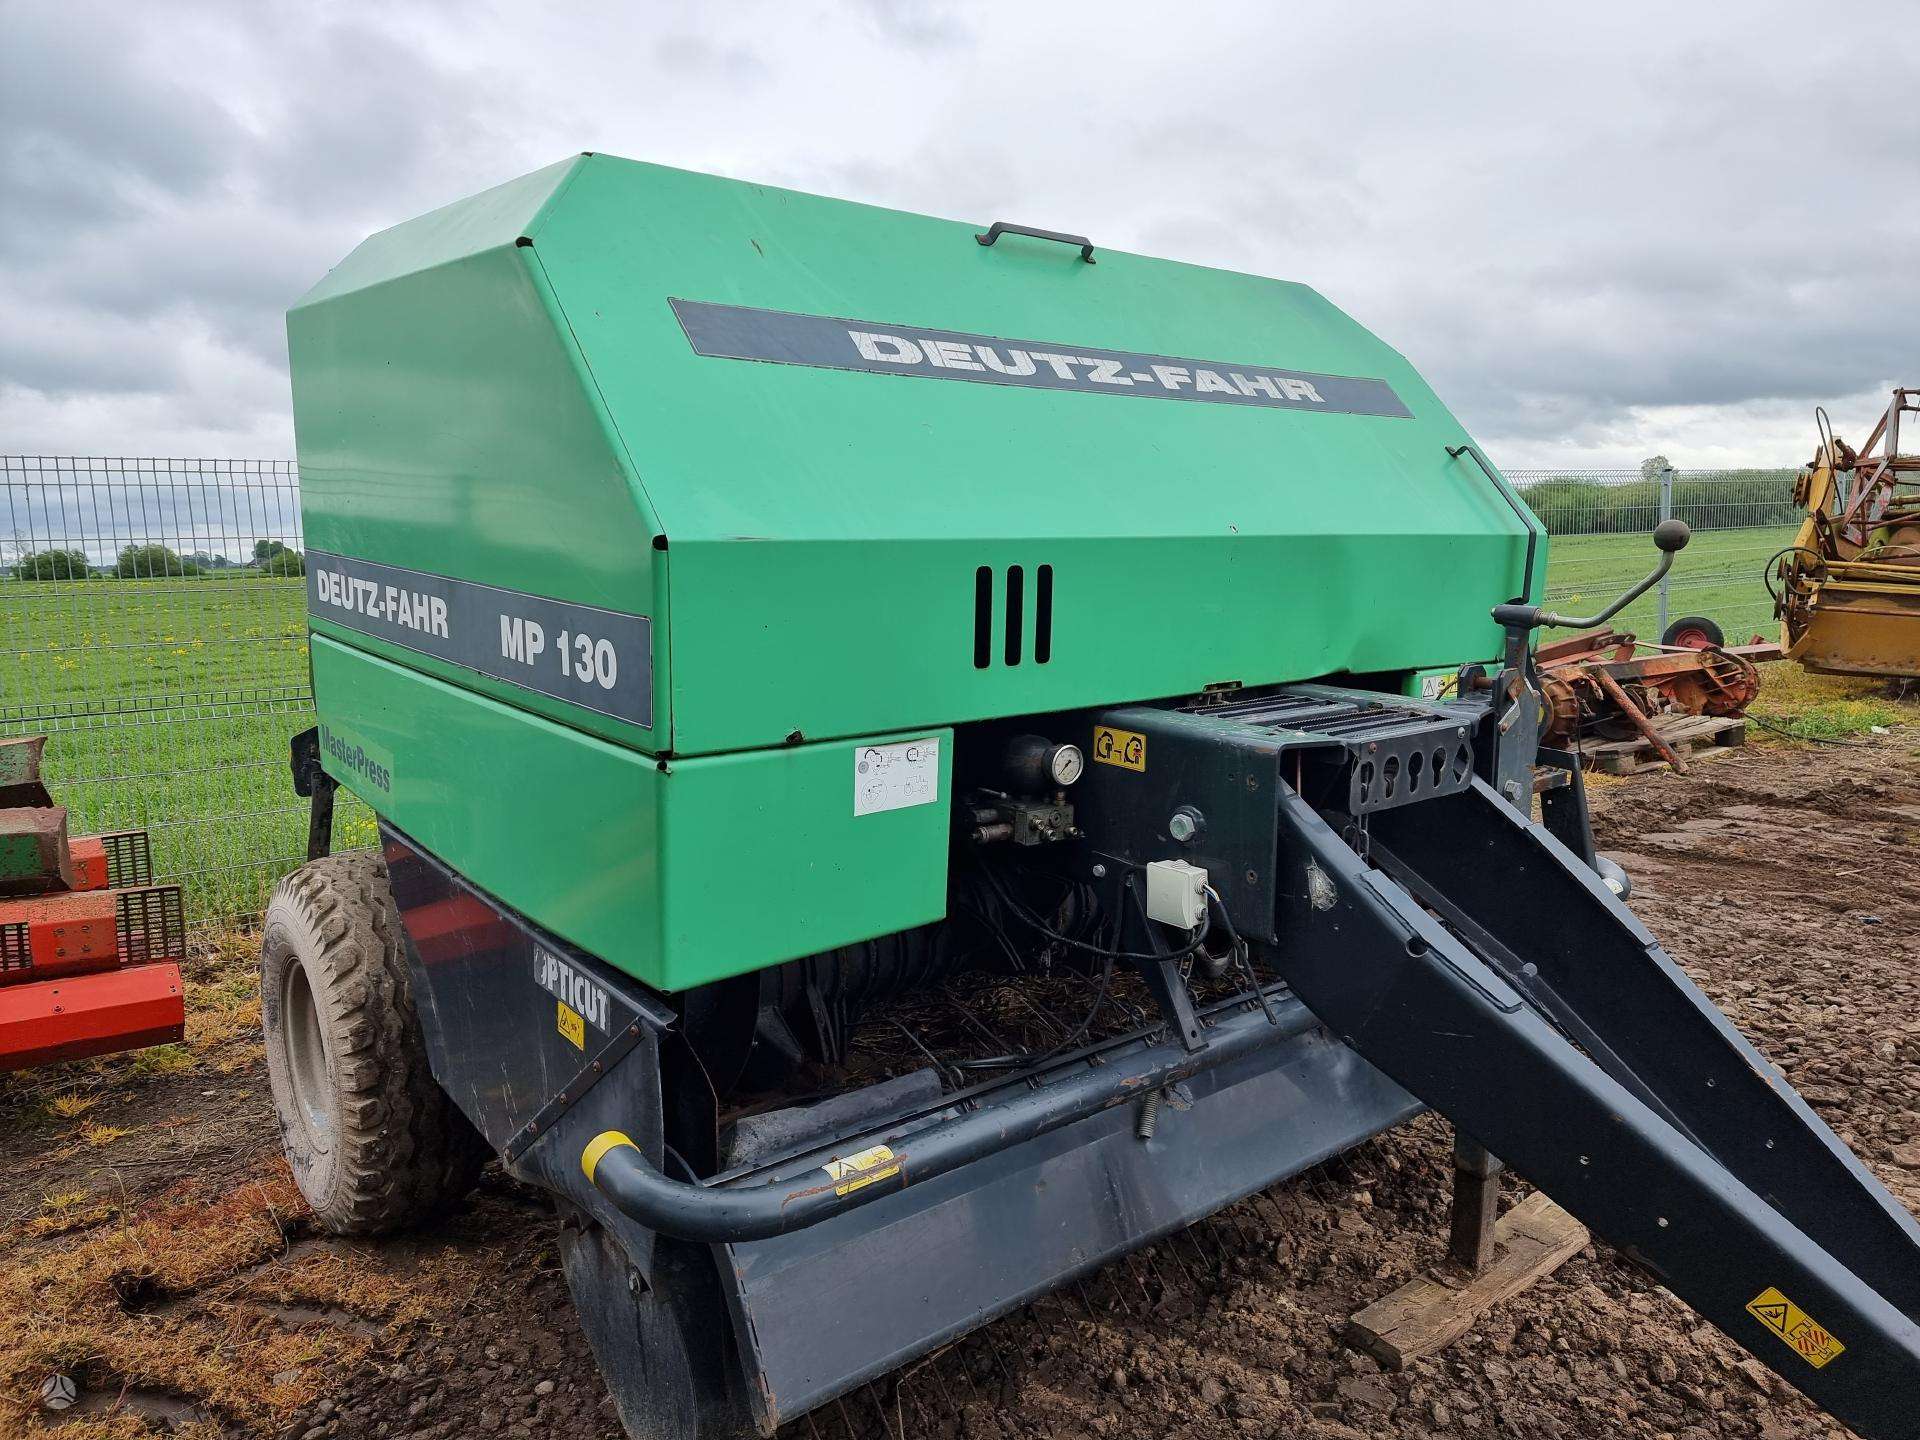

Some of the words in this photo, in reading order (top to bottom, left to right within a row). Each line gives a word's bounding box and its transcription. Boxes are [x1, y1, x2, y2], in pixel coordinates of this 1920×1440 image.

[848, 330, 1326, 403] DEUTZ-FAHR
[316, 569, 449, 639] DEUTZ-FAHR
[500, 614, 545, 666] MP
[556, 630, 618, 690] 130
[321, 724, 390, 793] MasterPress
